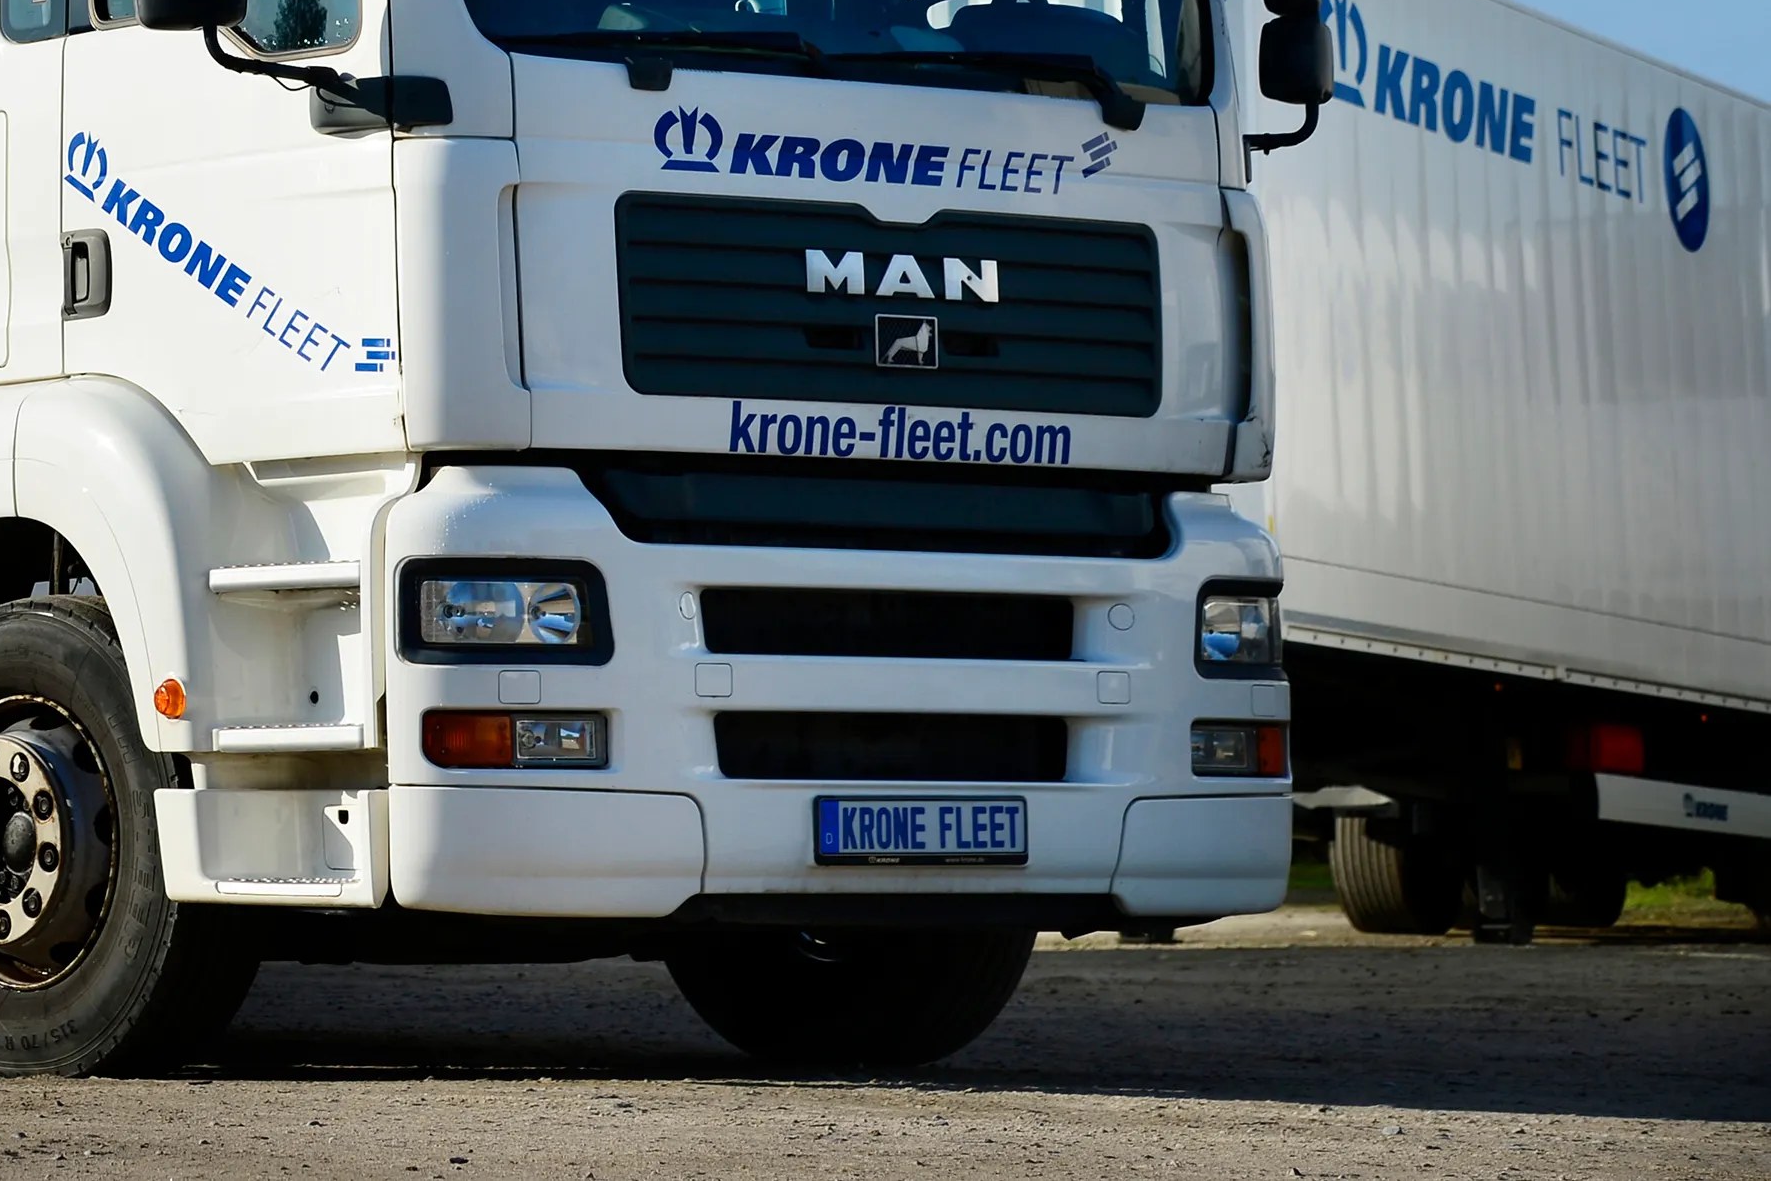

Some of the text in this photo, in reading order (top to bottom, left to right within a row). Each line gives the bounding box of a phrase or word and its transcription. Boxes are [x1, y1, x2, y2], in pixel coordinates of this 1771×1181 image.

[1374, 44, 1647, 204] KRONE FLEET
[730, 132, 1075, 195] KRONE FLEET
[101, 178, 351, 372] KRONE FLEET
[804, 249, 999, 303] MAN
[728, 400, 1072, 465] krone-fleet.com
[842, 805, 1020, 850] KRONE FLEET
[4, 1035, 15, 1051] R
[19, 1019, 80, 1051] 315/70
